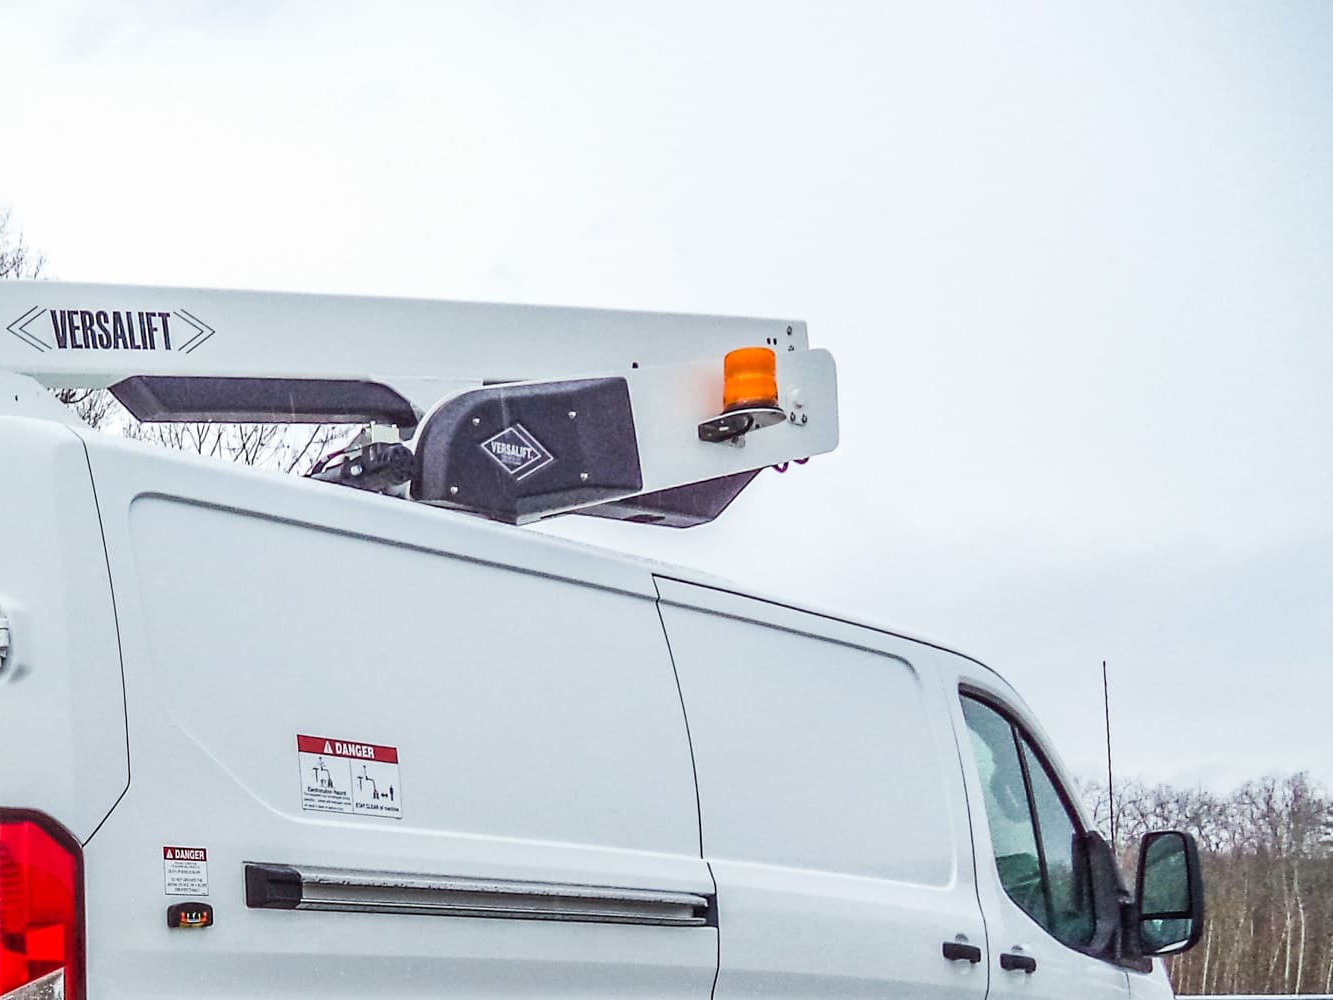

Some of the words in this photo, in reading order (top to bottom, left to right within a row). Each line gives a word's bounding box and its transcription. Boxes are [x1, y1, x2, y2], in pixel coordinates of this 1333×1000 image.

[50, 309, 172, 350] VERSALIFT
[335, 741, 375, 759] DANGER
[174, 849, 205, 860] DANGER
